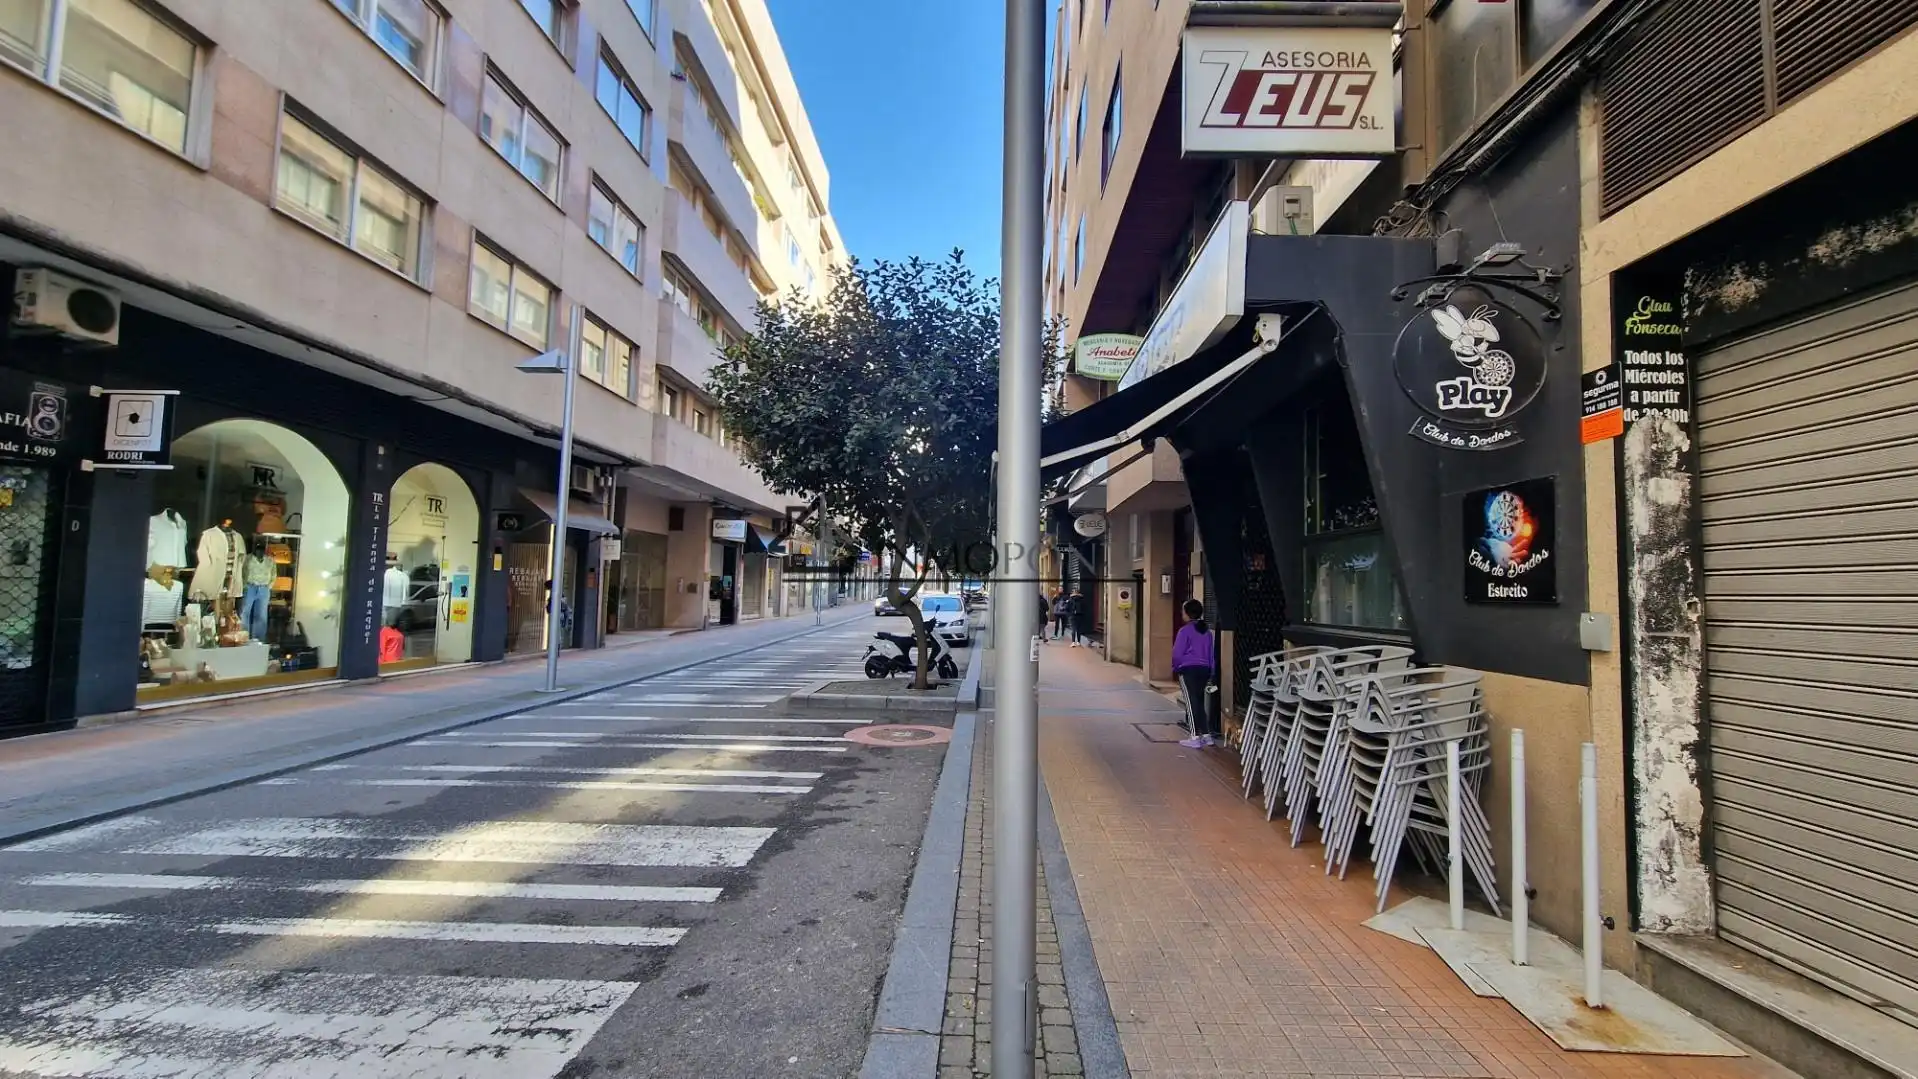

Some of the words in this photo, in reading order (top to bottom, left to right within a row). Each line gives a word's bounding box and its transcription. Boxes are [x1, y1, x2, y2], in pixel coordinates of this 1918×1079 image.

[1261, 51, 1371, 68] ASESORIA
[1200, 50, 1376, 129] ZEUS
[1359, 115, 1384, 130] S.L.
[1633, 295, 1673, 320] Glau
[1625, 317, 1682, 336] Fonseca
[1624, 350, 1662, 365] Todos
[1666, 350, 1684, 366] los
[1624, 368, 1685, 384] Miércoles
[1437, 378, 1511, 416] Play
[1583, 380, 1619, 398] segurma
[1630, 391, 1639, 403] a
[1643, 390, 1680, 405] partir
[1624, 408, 1639, 422] de
[1423, 422, 1449, 442] Club
[1451, 436, 1465, 446] de
[1468, 429, 1512, 448] Dardos
[24, 444, 56, 457] 1.989
[107, 451, 143, 460] RODRI
[372, 492, 384, 502] TR
[426, 497, 443, 514] TR
[1468, 549, 1490, 573] Club
[1491, 561, 1504, 576] de
[1507, 549, 1549, 578] Dardos
[1487, 583, 1528, 598] Estreito
